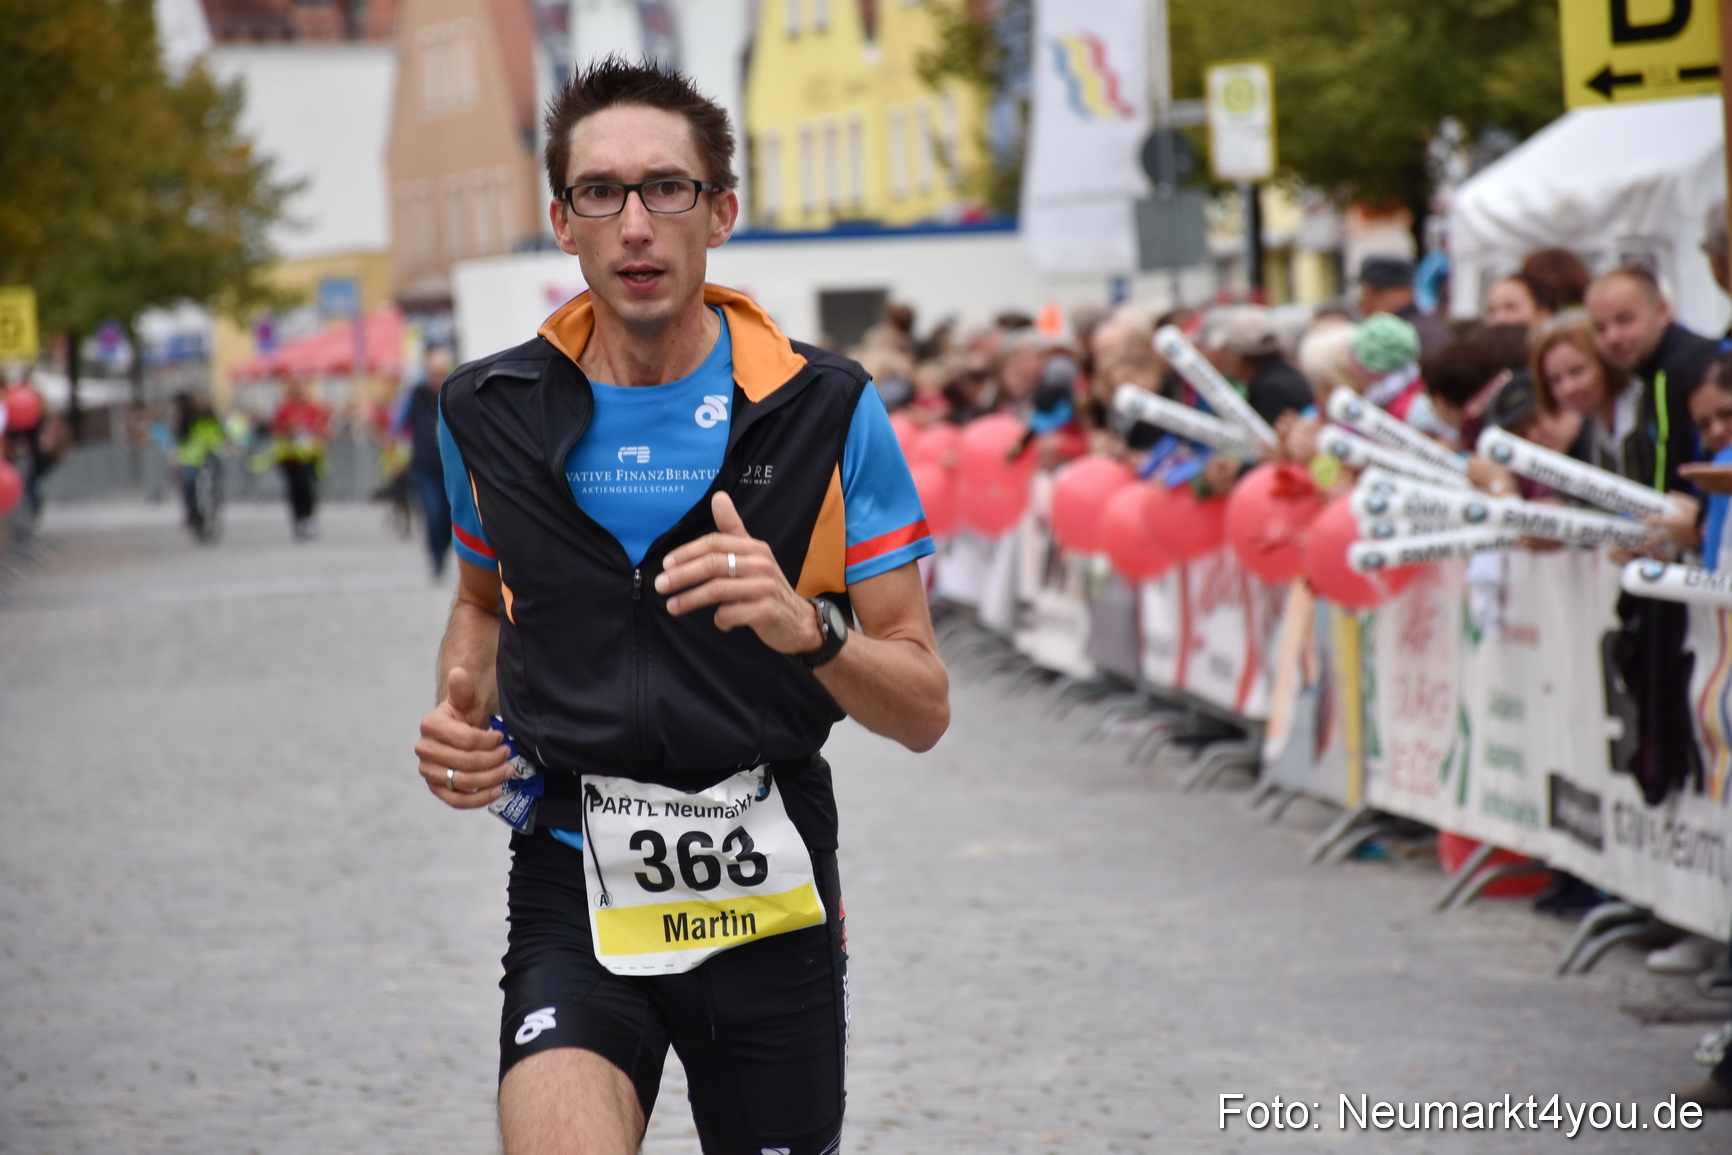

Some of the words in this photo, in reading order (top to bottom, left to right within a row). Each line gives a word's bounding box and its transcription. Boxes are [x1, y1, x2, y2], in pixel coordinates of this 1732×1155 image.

[581, 484, 686, 495] AKTIENGESELLSCHAFT
[589, 796, 659, 818] PARTL
[664, 792, 753, 820] Neumarkt
[629, 825, 769, 893] 363
[662, 909, 757, 944] Martin
